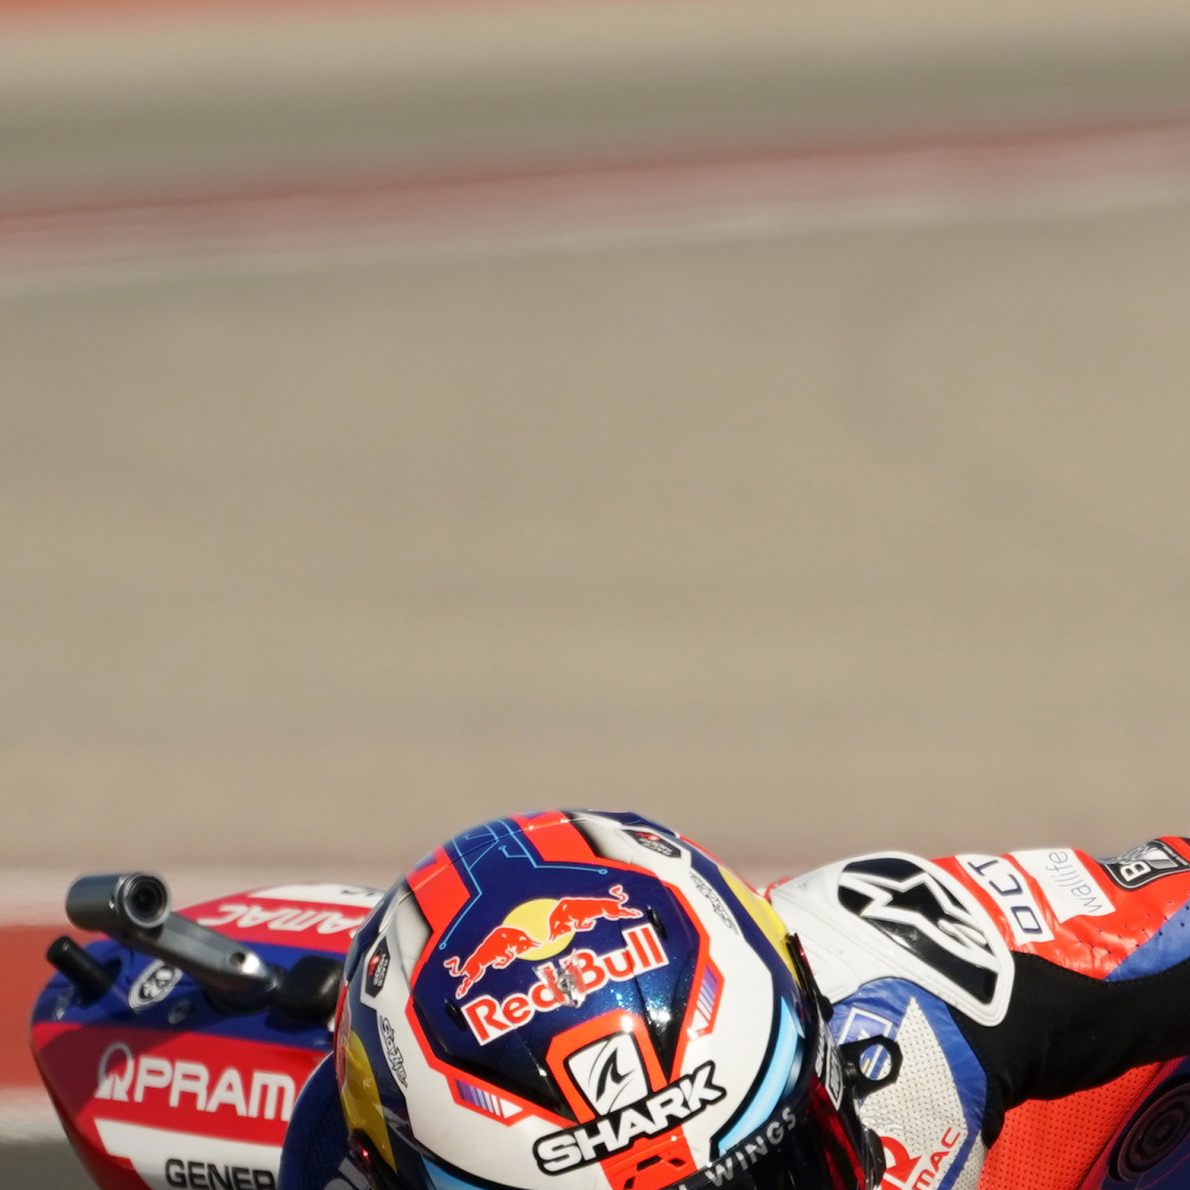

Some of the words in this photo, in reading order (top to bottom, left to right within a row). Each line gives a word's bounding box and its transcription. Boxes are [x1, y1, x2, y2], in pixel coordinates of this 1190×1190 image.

[967, 859, 1043, 935] OCT
[462, 963, 567, 1045] Red
[562, 924, 668, 996] Bull
[134, 1056, 296, 1122] PRAM
[537, 1064, 723, 1173] SHARK
[704, 1106, 799, 1189] WINGS
